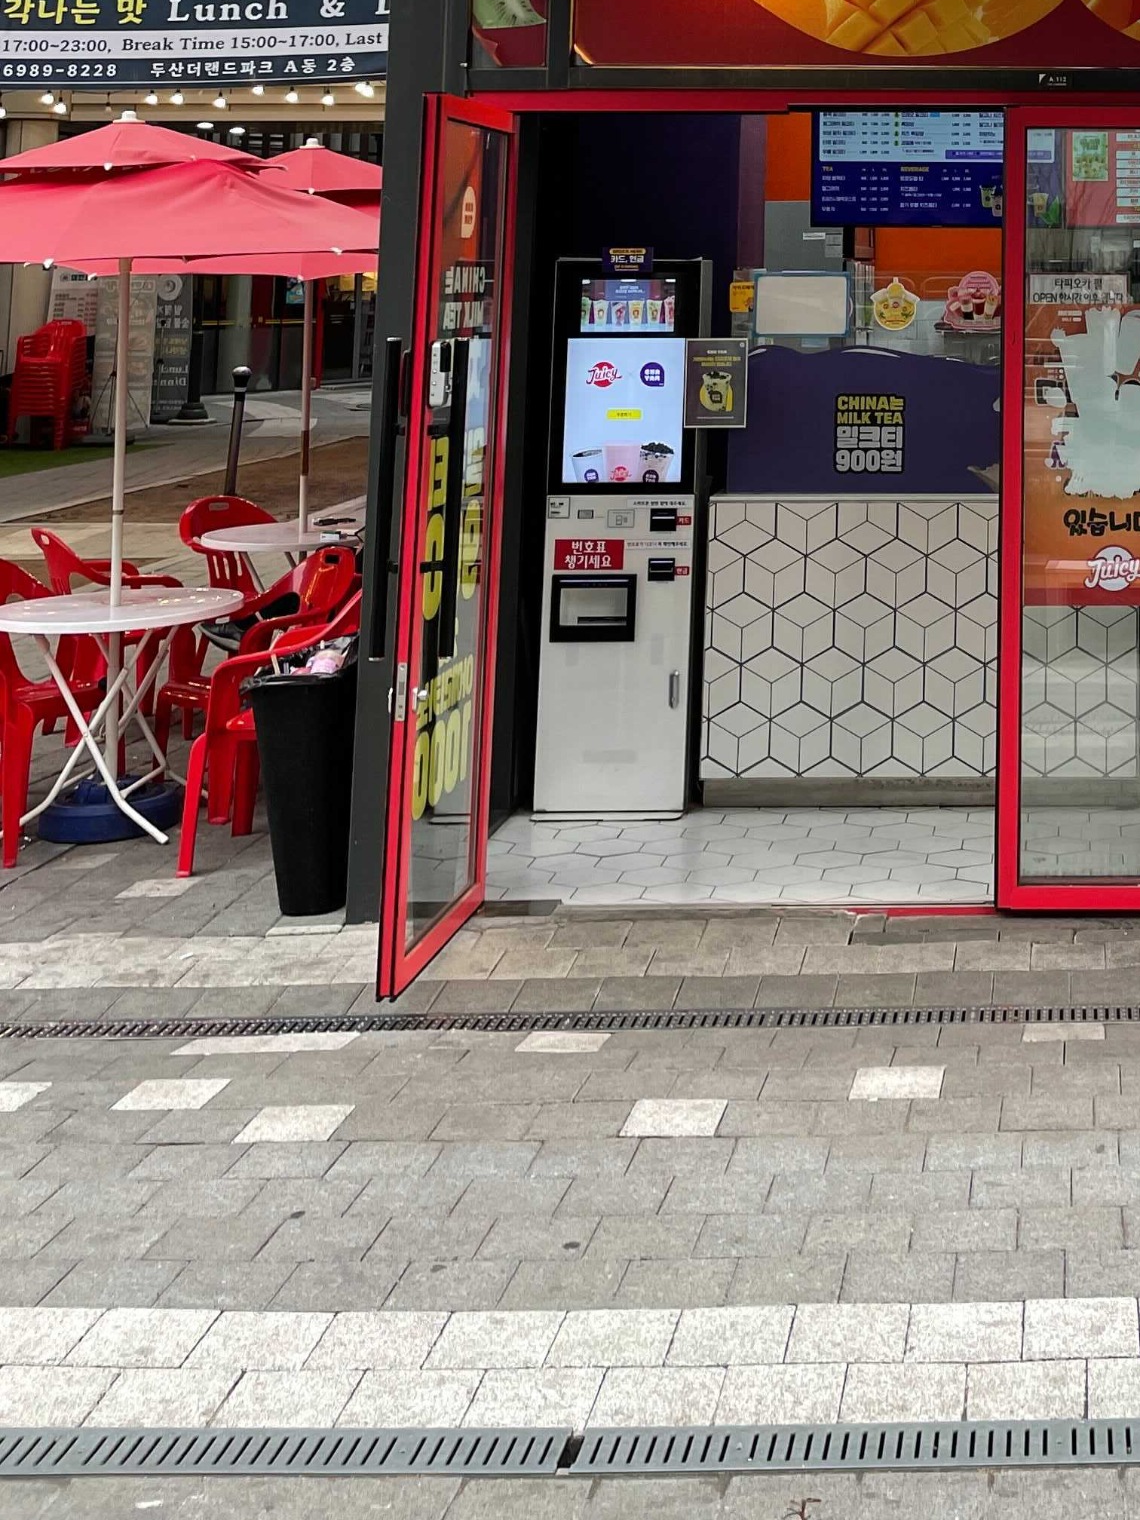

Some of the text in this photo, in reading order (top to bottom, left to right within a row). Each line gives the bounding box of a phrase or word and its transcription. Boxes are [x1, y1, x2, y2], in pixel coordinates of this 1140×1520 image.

[121, 37, 174, 52] Break
[180, 36, 225, 51] Time
[231, 33, 340, 50] 15:00~17:00,
[345, 31, 382, 46] Last
[150, 60, 274, 78] 두산더랜드파크
[284, 58, 317, 74] A동
[326, 56, 356, 72] 2층
[1032, 292, 1057, 303] OPEN
[586, 367, 623, 385] Juicy
[837, 395, 904, 411] CHINA는
[837, 411, 904, 424] MILK TEA
[836, 425, 904, 449] 밀크티
[835, 449, 903, 472] 900원
[571, 540, 607, 555] 번호표
[564, 554, 612, 570] 챙기세요
